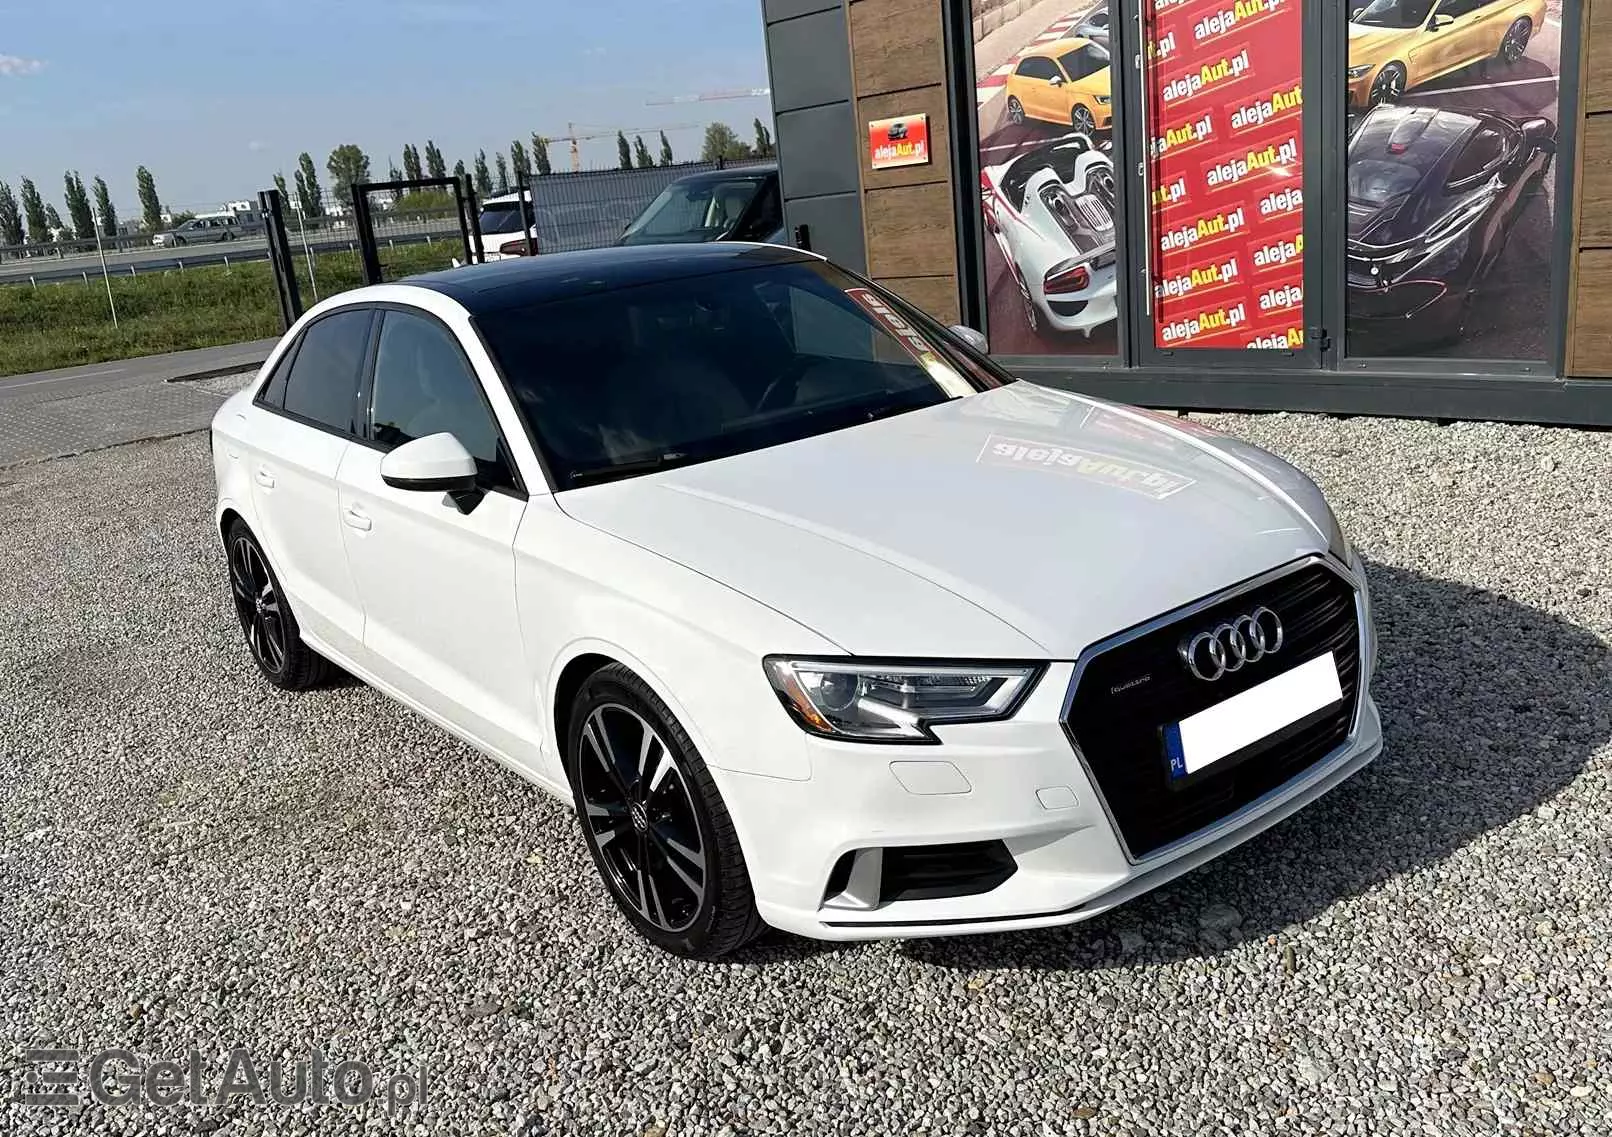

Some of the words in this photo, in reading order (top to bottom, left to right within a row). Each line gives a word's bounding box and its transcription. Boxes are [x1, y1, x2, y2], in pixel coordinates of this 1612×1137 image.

[1194, 0, 1285, 40] alejaAut.p
[1163, 49, 1249, 101] alejaAut.pl
[875, 140, 925, 160] alejaAut.pl
[1207, 138, 1297, 186] alejaAut.pl
[1161, 207, 1244, 250] alejaAut.pl
[1154, 258, 1238, 298] alejaAut.pl
[1162, 303, 1246, 341] alejaAut.pl
[1170, 757, 1184, 771] PL
